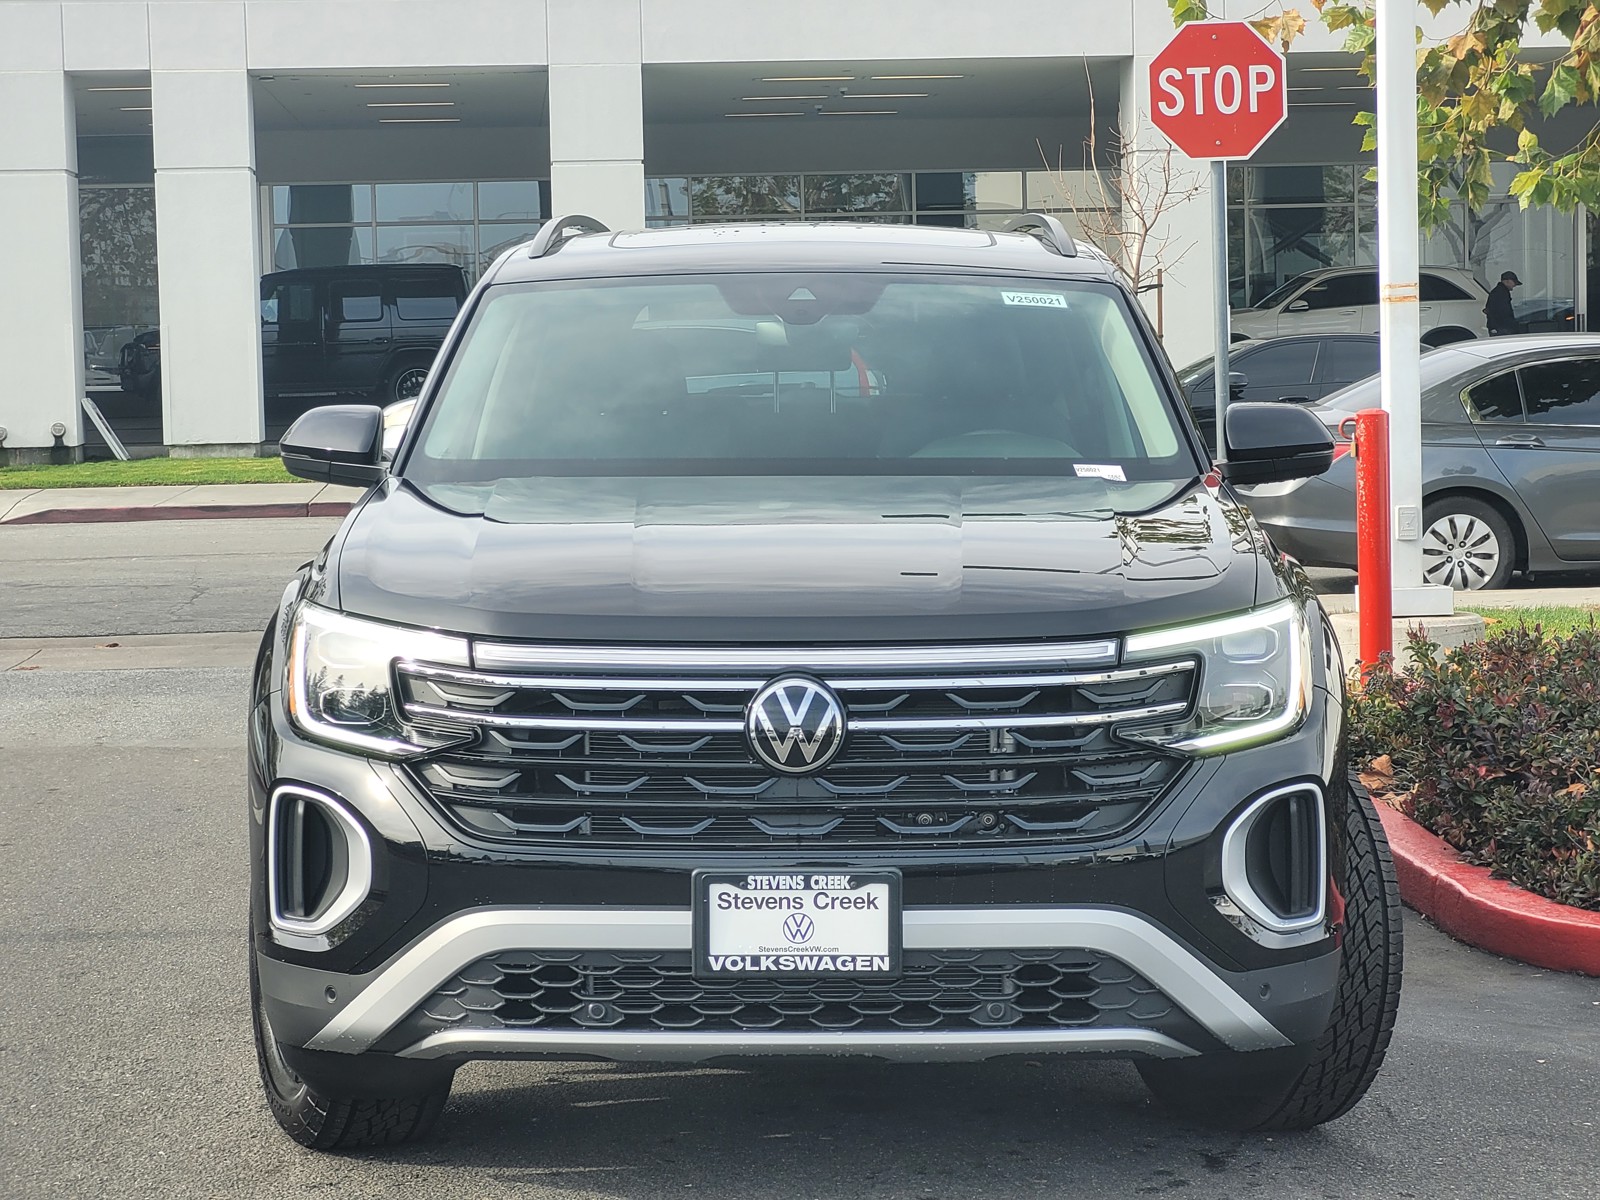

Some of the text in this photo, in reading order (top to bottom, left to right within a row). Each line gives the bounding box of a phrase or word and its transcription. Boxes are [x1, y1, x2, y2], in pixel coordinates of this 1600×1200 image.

[1157, 64, 1276, 117] STOP
[1006, 294, 1062, 306] V250021
[747, 875, 851, 890] STEVENS CREEK
[717, 891, 879, 910] Stevens Creek
[758, 945, 839, 953] StevensCreekVW.com
[708, 955, 890, 971] VOLKSWAGEN
